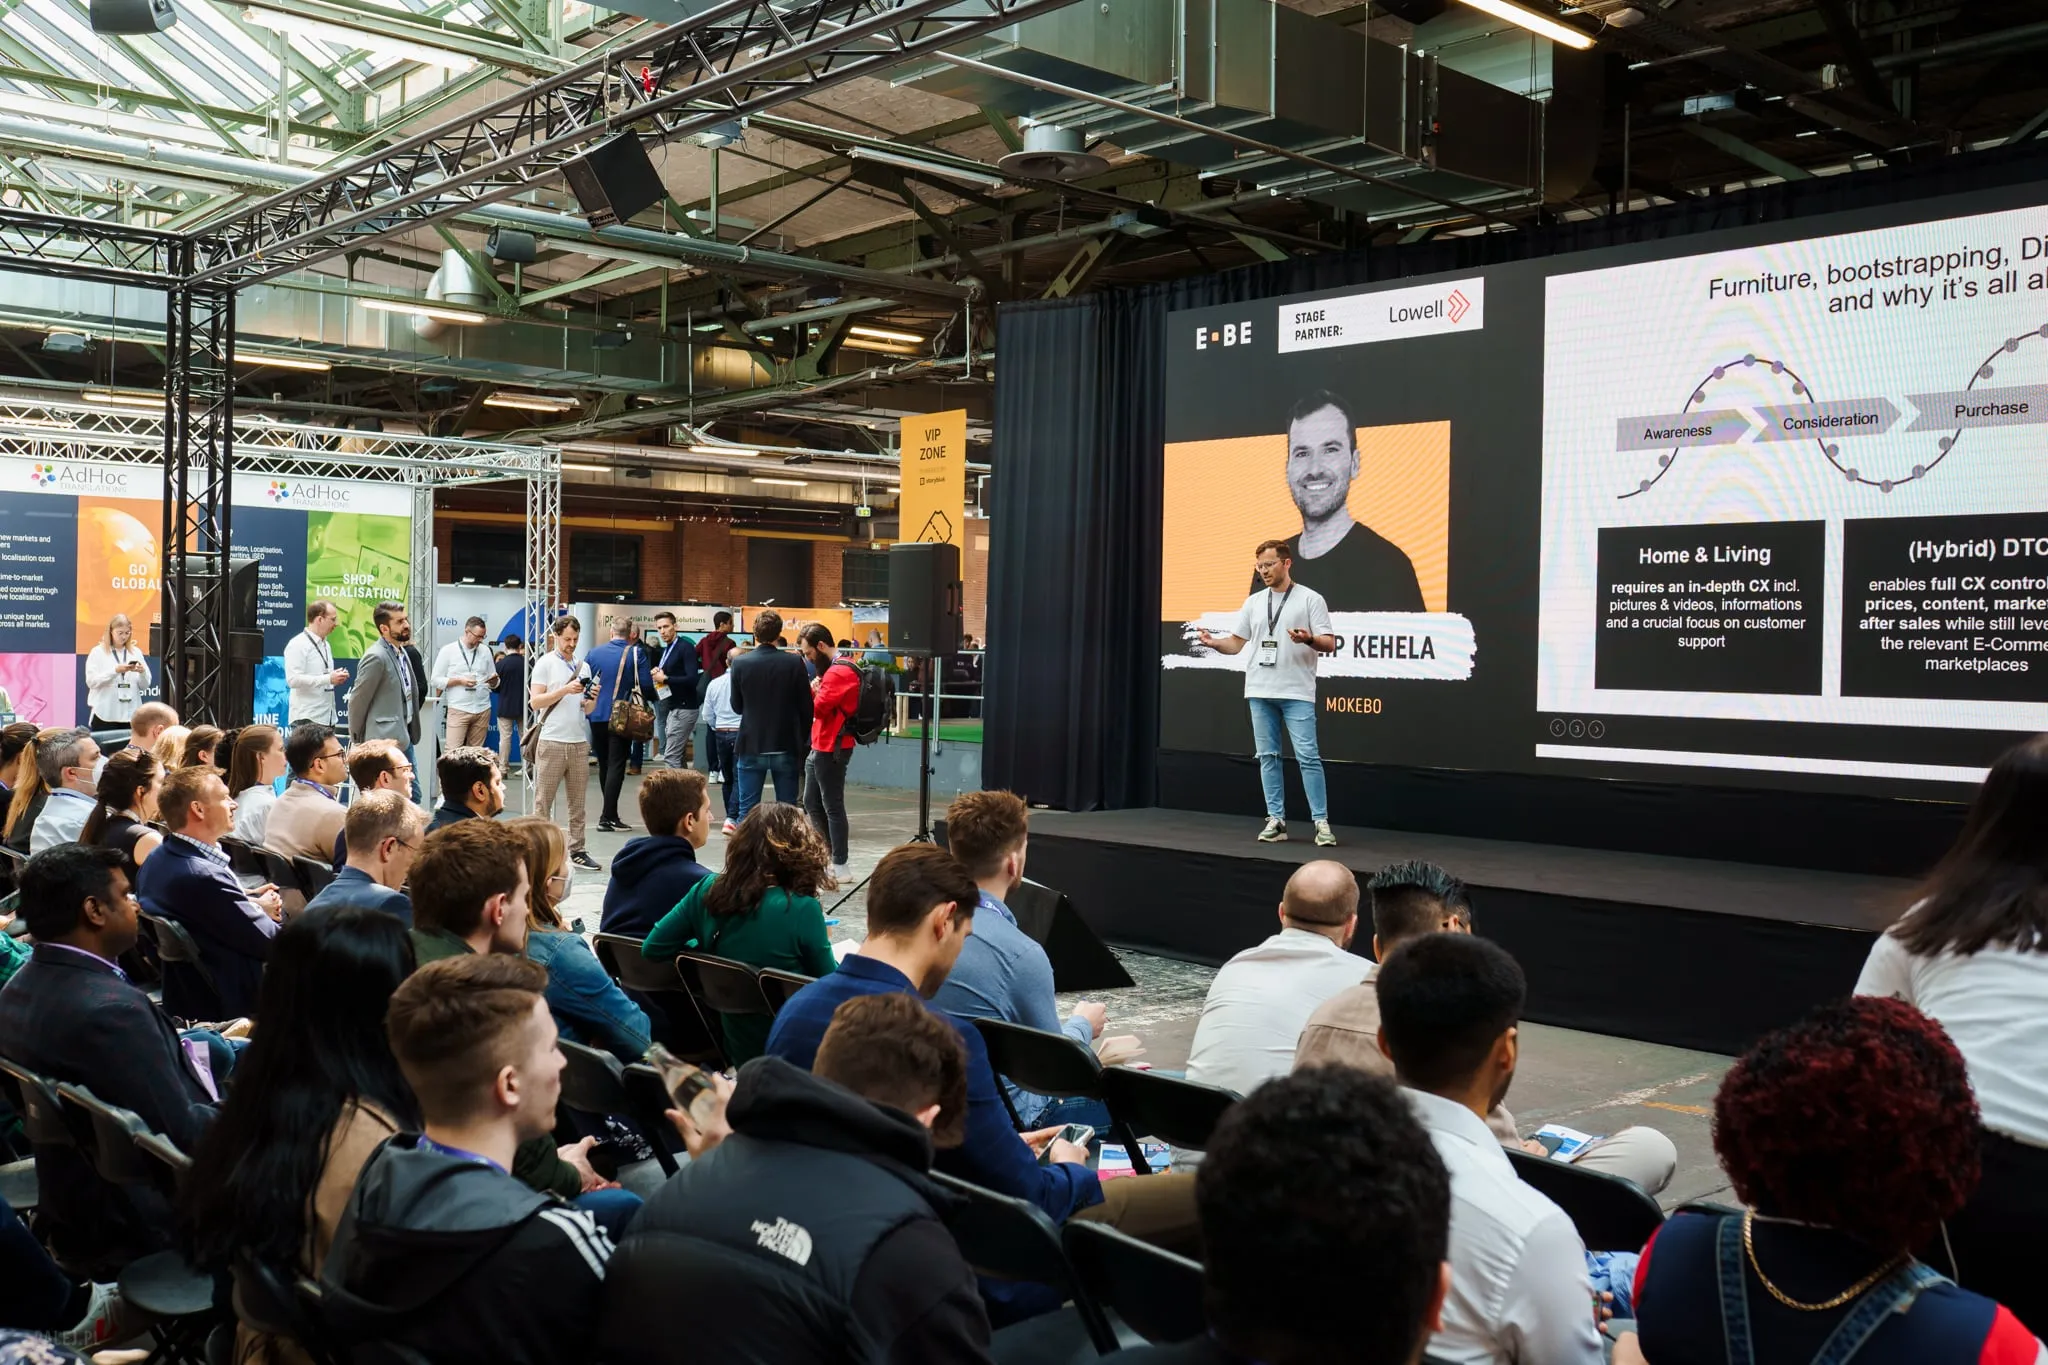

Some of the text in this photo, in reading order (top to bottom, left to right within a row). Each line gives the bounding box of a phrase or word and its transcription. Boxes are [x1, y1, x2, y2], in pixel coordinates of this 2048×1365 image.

[1709, 270, 1818, 299] Furniture,
[1827, 244, 2010, 286] bootstrapping,
[1828, 288, 1874, 314] and
[1883, 282, 1934, 308] why
[1988, 270, 2018, 295] all
[1294, 310, 1326, 325] STAGE
[1389, 299, 1444, 324] Lowell
[1294, 325, 1343, 342] PARTNER:
[1954, 400, 2030, 419] Purchase
[1783, 412, 1879, 431] Consideration
[925, 428, 941, 442] VIP
[1643, 425, 1712, 441] Awareness
[920, 446, 946, 460] ZONE
[60, 466, 128, 486] AdHoc
[292, 482, 350, 501] AdHoc
[12, 534, 38, 542] markets
[39, 535, 51, 543] and
[1, 553, 38, 562] localisation
[1639, 545, 1771, 565] Home & Living
[1908, 539, 1997, 563] (Hybrid)
[128, 563, 148, 576] GO
[111, 576, 162, 591] GLOBAL
[343, 573, 375, 585] SHOP
[1868, 577, 1927, 591] enables
[1930, 576, 1957, 591] full
[1961, 576, 1986, 591] CX
[34, 586, 59, 596] through
[316, 586, 400, 599] LOCALISATION
[1611, 578, 1800, 596] requires an in-depth CX incl.
[9, 592, 45, 601] localisation
[264, 600, 294, 609] Translation
[1609, 597, 1803, 613] pictures & videos, informations
[1865, 596, 2048, 613] prices, content, marke
[3, 612, 25, 622] unique
[25, 612, 44, 621] brand
[16, 620, 24, 628] all
[24, 620, 50, 629] markets
[436, 617, 458, 627] Web
[1606, 616, 1806, 630] and a crucial focus on customer
[1859, 616, 1896, 631] after
[1898, 616, 1941, 631] sales
[1945, 616, 1985, 630] while
[1989, 616, 2015, 631] still
[1353, 634, 1436, 660] KEHELA
[1678, 634, 1726, 650] support
[1880, 636, 1904, 650] the
[1908, 636, 1969, 651] relevant
[1925, 656, 2030, 674] marketplaces
[1326, 696, 1382, 714] MOKEBO
